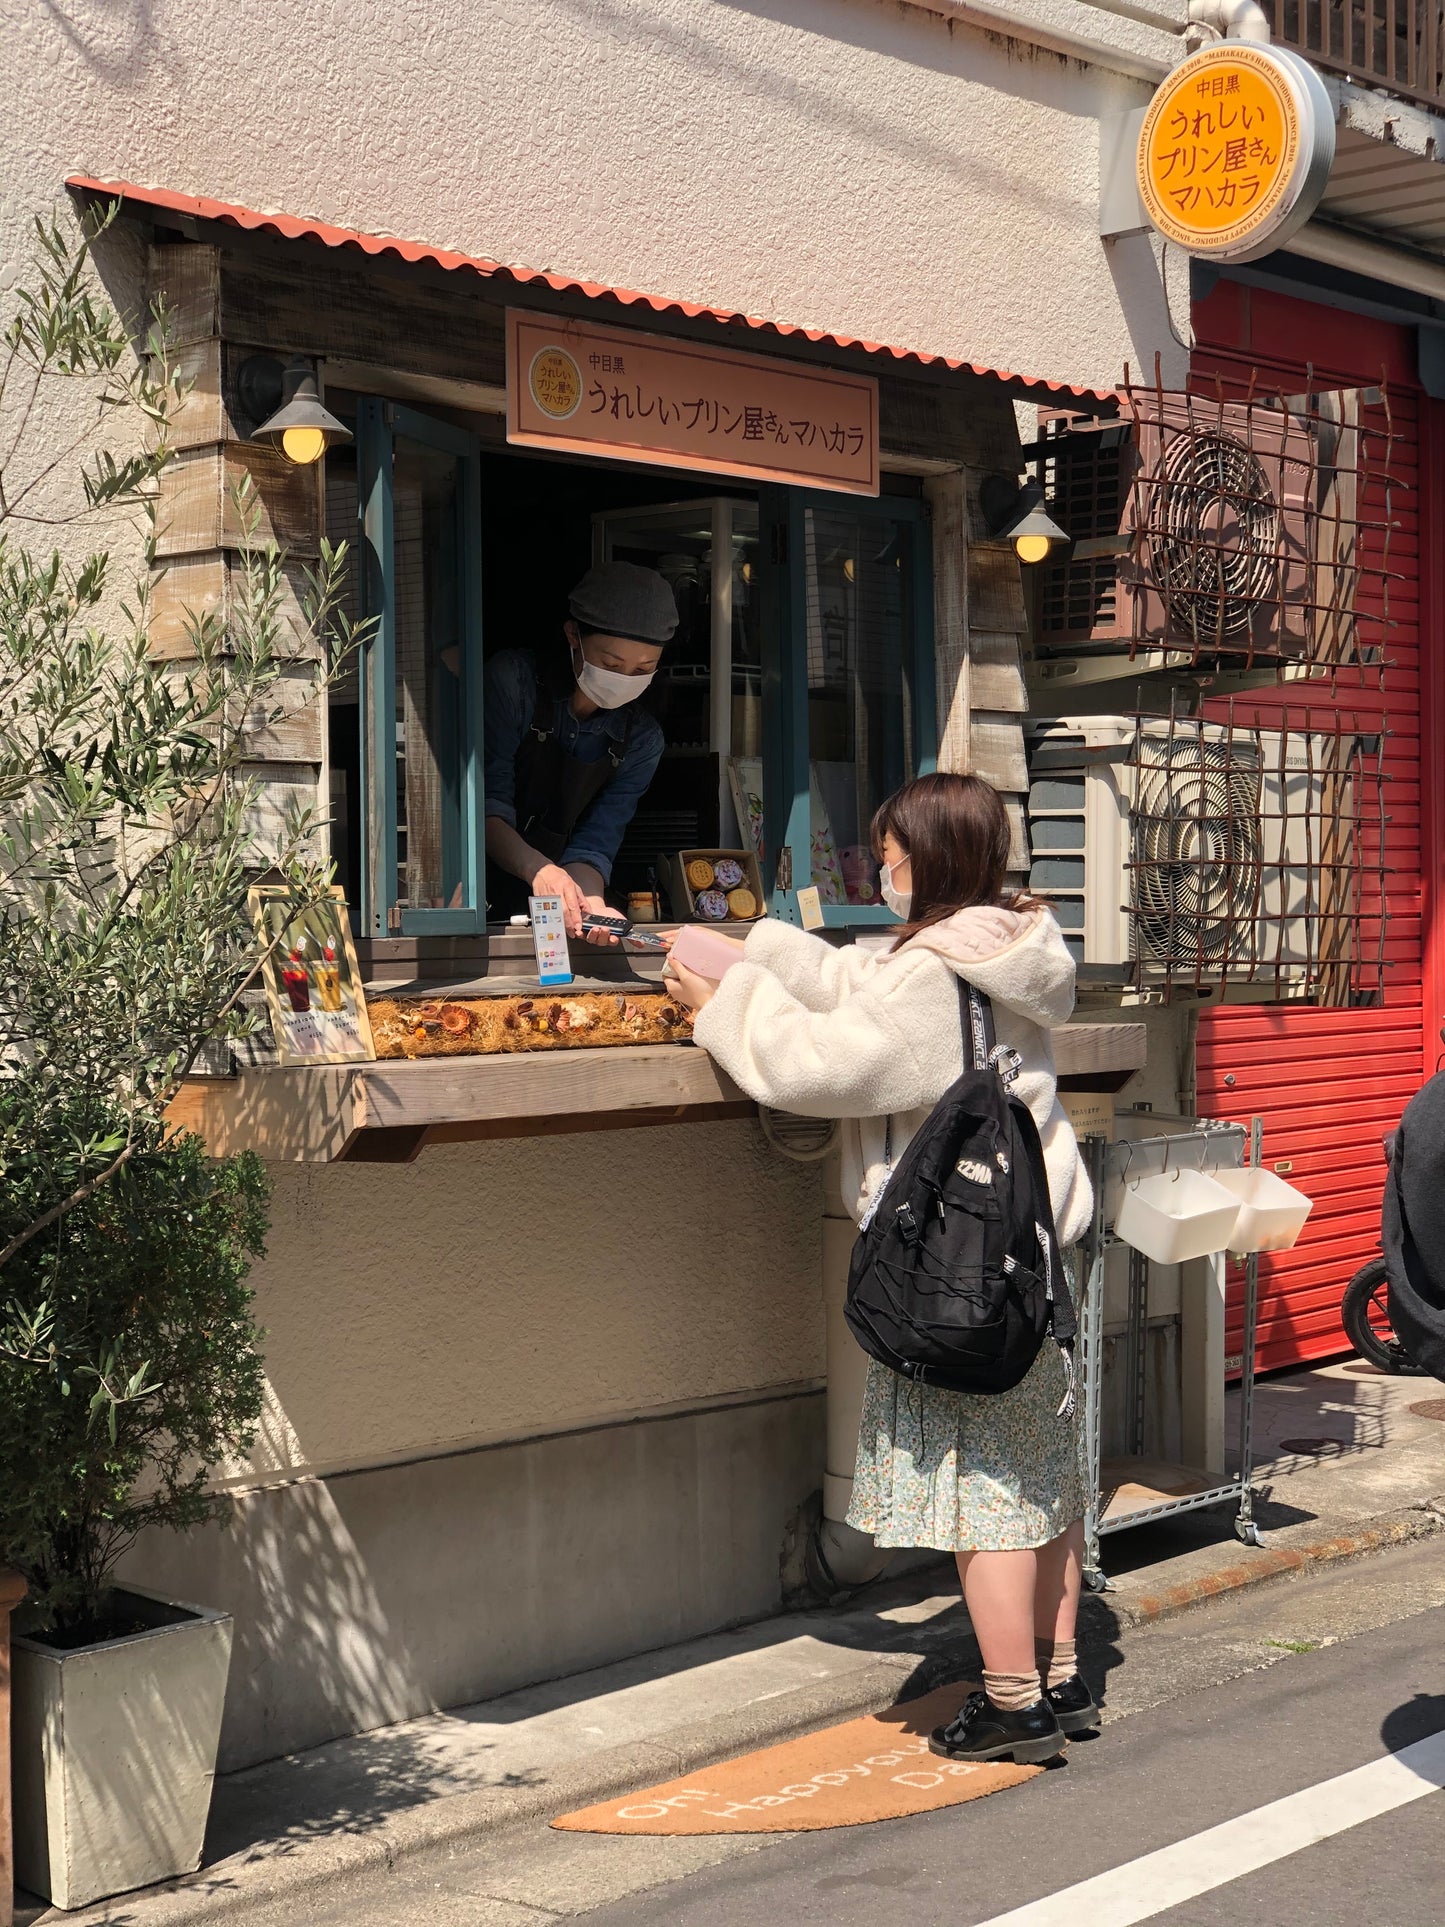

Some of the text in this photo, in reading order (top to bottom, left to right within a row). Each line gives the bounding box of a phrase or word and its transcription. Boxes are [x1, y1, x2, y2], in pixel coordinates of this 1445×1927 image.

[1167, 67, 1187, 88] SINCE
[1256, 57, 1276, 77] HAPPY
[1197, 74, 1240, 99] 中目黒
[1171, 101, 1265, 140] うれしい
[1157, 137, 1277, 180] プリン屋さん
[1169, 174, 1260, 211] マハカラ
[541, 366, 571, 380] うれしい
[589, 352, 625, 375] 中目黒
[537, 379, 575, 395] プリン屋さん
[541, 393, 571, 406] マハカラ
[588, 379, 864, 456] うれしいプリン屋さんマハカラ
[890, 1761, 999, 1790] Da
[616, 1788, 720, 1819] Oh!
